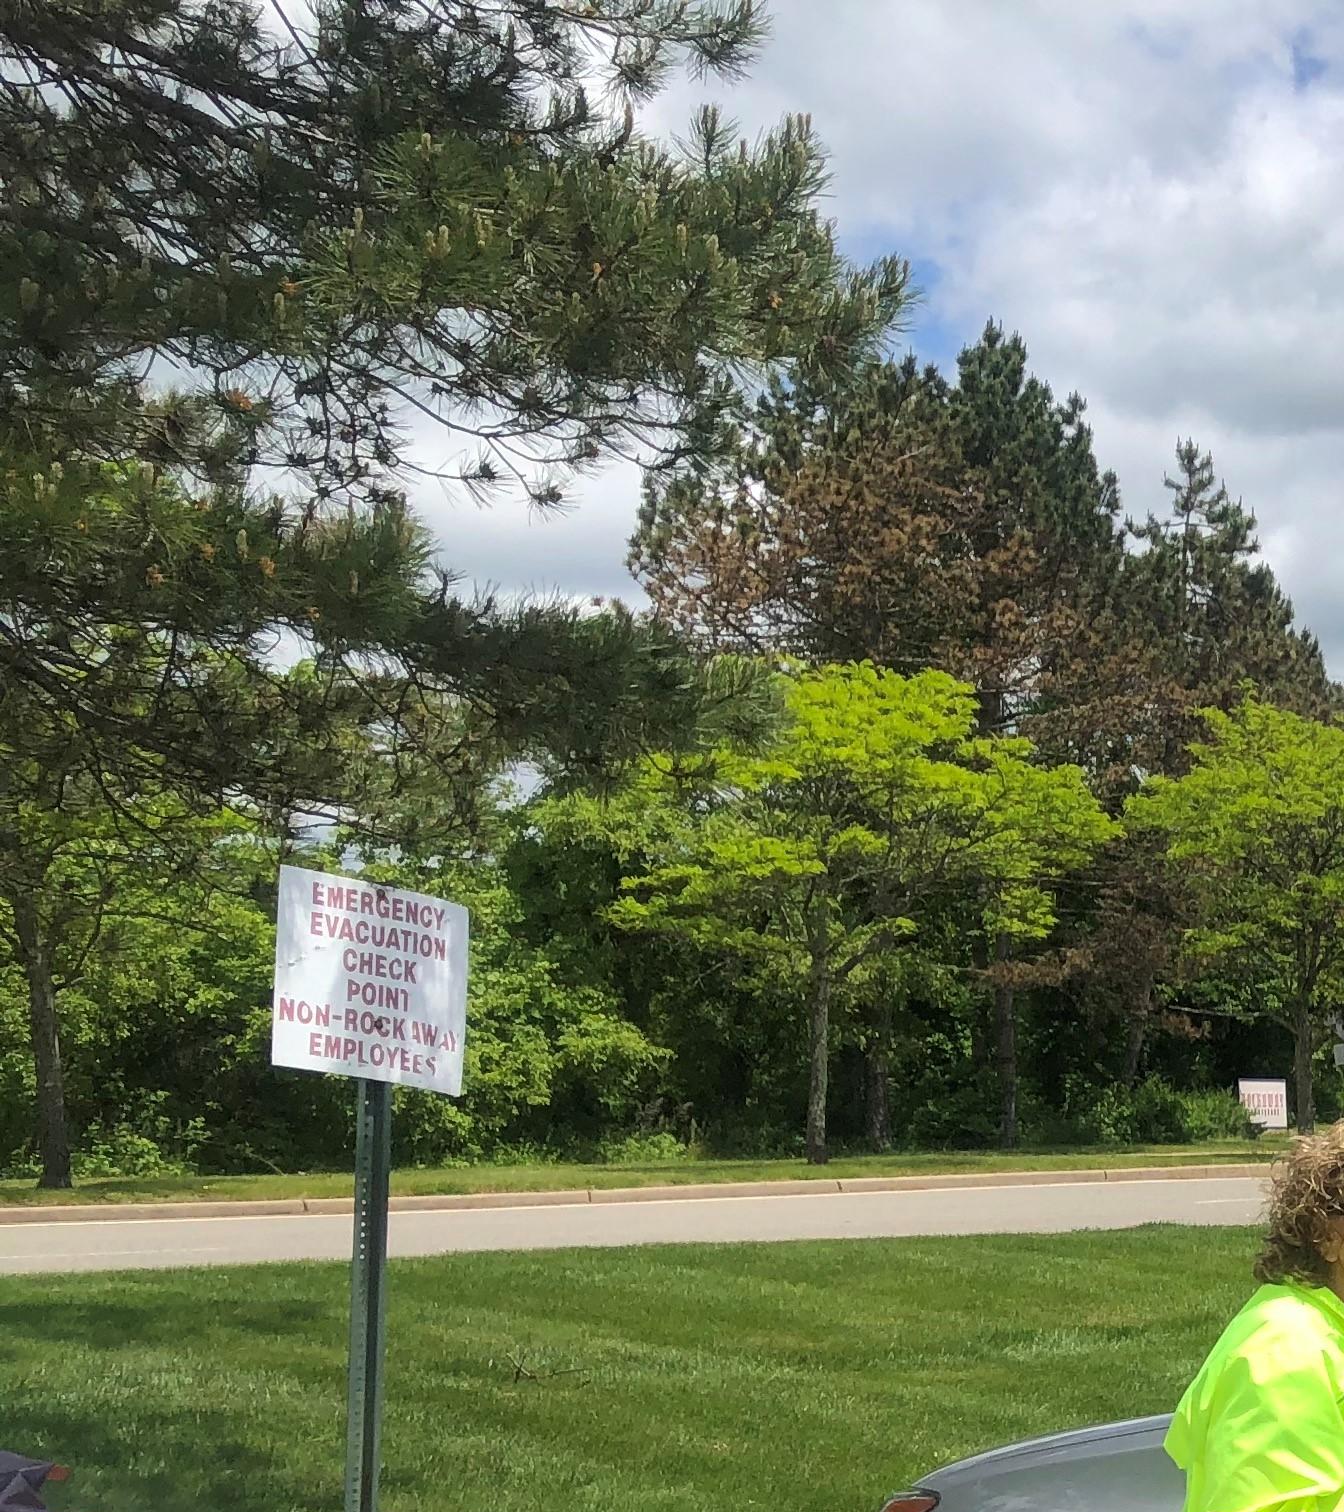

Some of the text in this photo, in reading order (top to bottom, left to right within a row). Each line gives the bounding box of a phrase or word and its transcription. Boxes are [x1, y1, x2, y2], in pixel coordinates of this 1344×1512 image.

[312, 881, 446, 931] EMERGENCY
[310, 911, 447, 962] EVACUATION
[342, 948, 418, 985] CHECK
[346, 978, 409, 1012] POINT
[309, 1032, 437, 1077] EMPLOYEES
